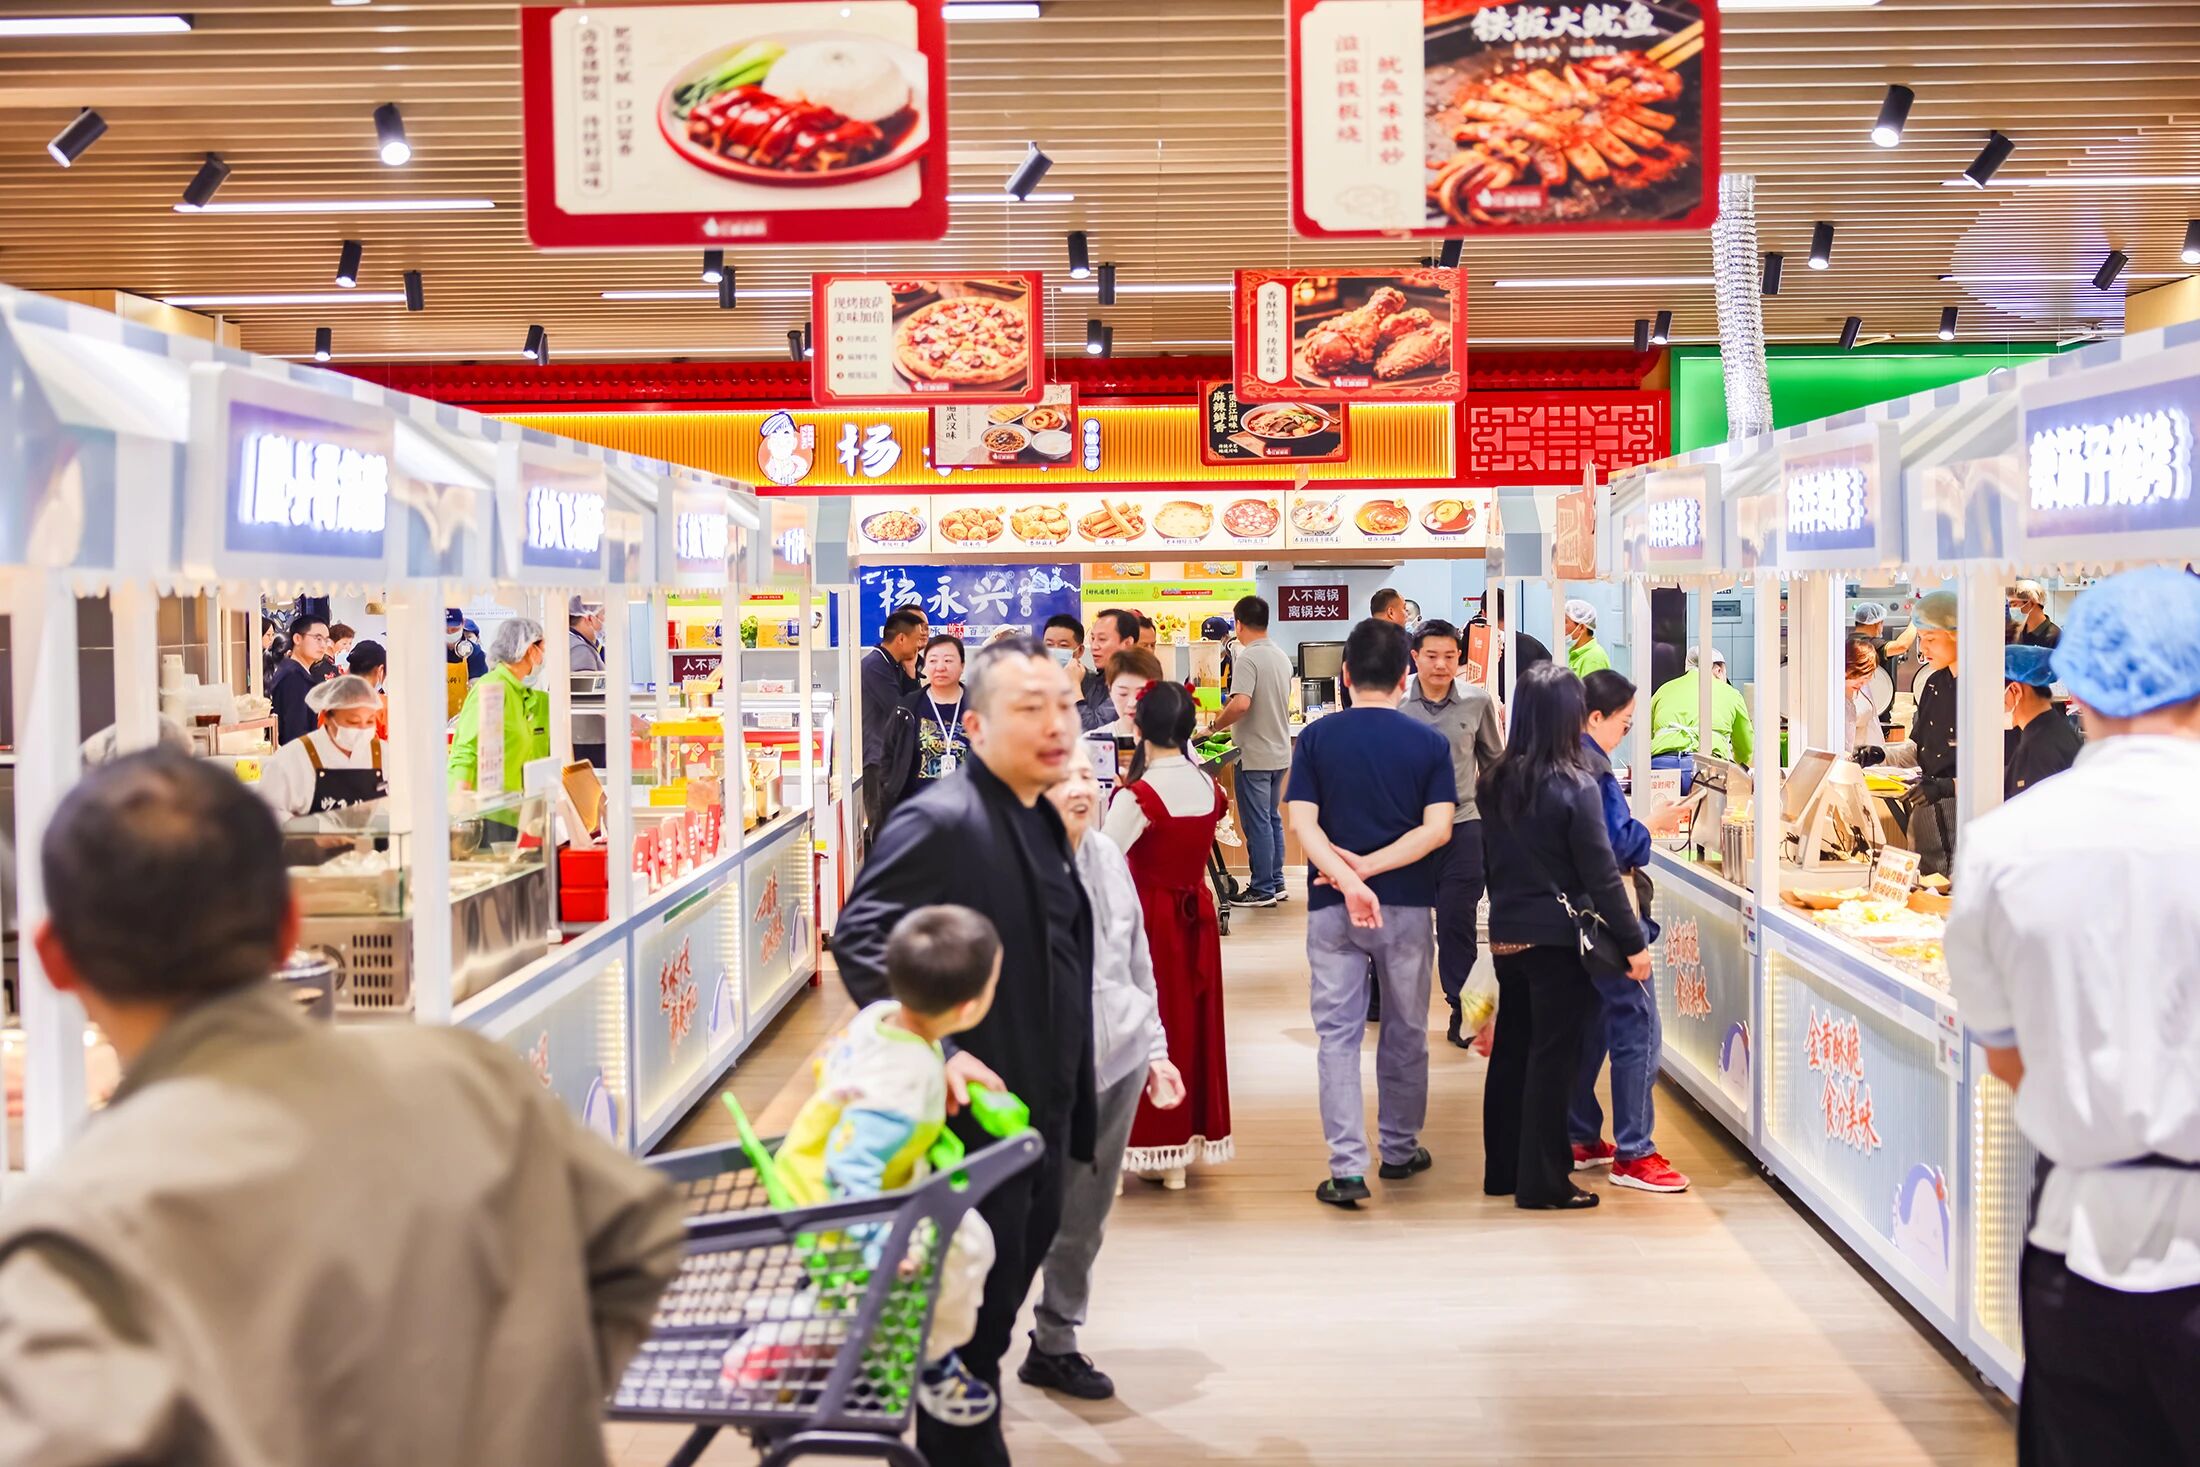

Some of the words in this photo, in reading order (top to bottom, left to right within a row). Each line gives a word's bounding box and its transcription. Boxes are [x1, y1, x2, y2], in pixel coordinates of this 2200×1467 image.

[1471, 4, 1659, 43] 铁板大鱿鱼
[833, 296, 884, 309] 现烤披萨
[834, 311, 885, 325] 美味加倍
[1212, 390, 1227, 433] 麻辣鲜香
[880, 574, 1014, 618] 杨永兴
[1287, 604, 1340, 618] 离锅关火
[1288, 588, 1340, 602] 人不离锅
[1804, 1006, 1864, 1081] 金黄酥脆
[1821, 1075, 1882, 1157] 食分美味
